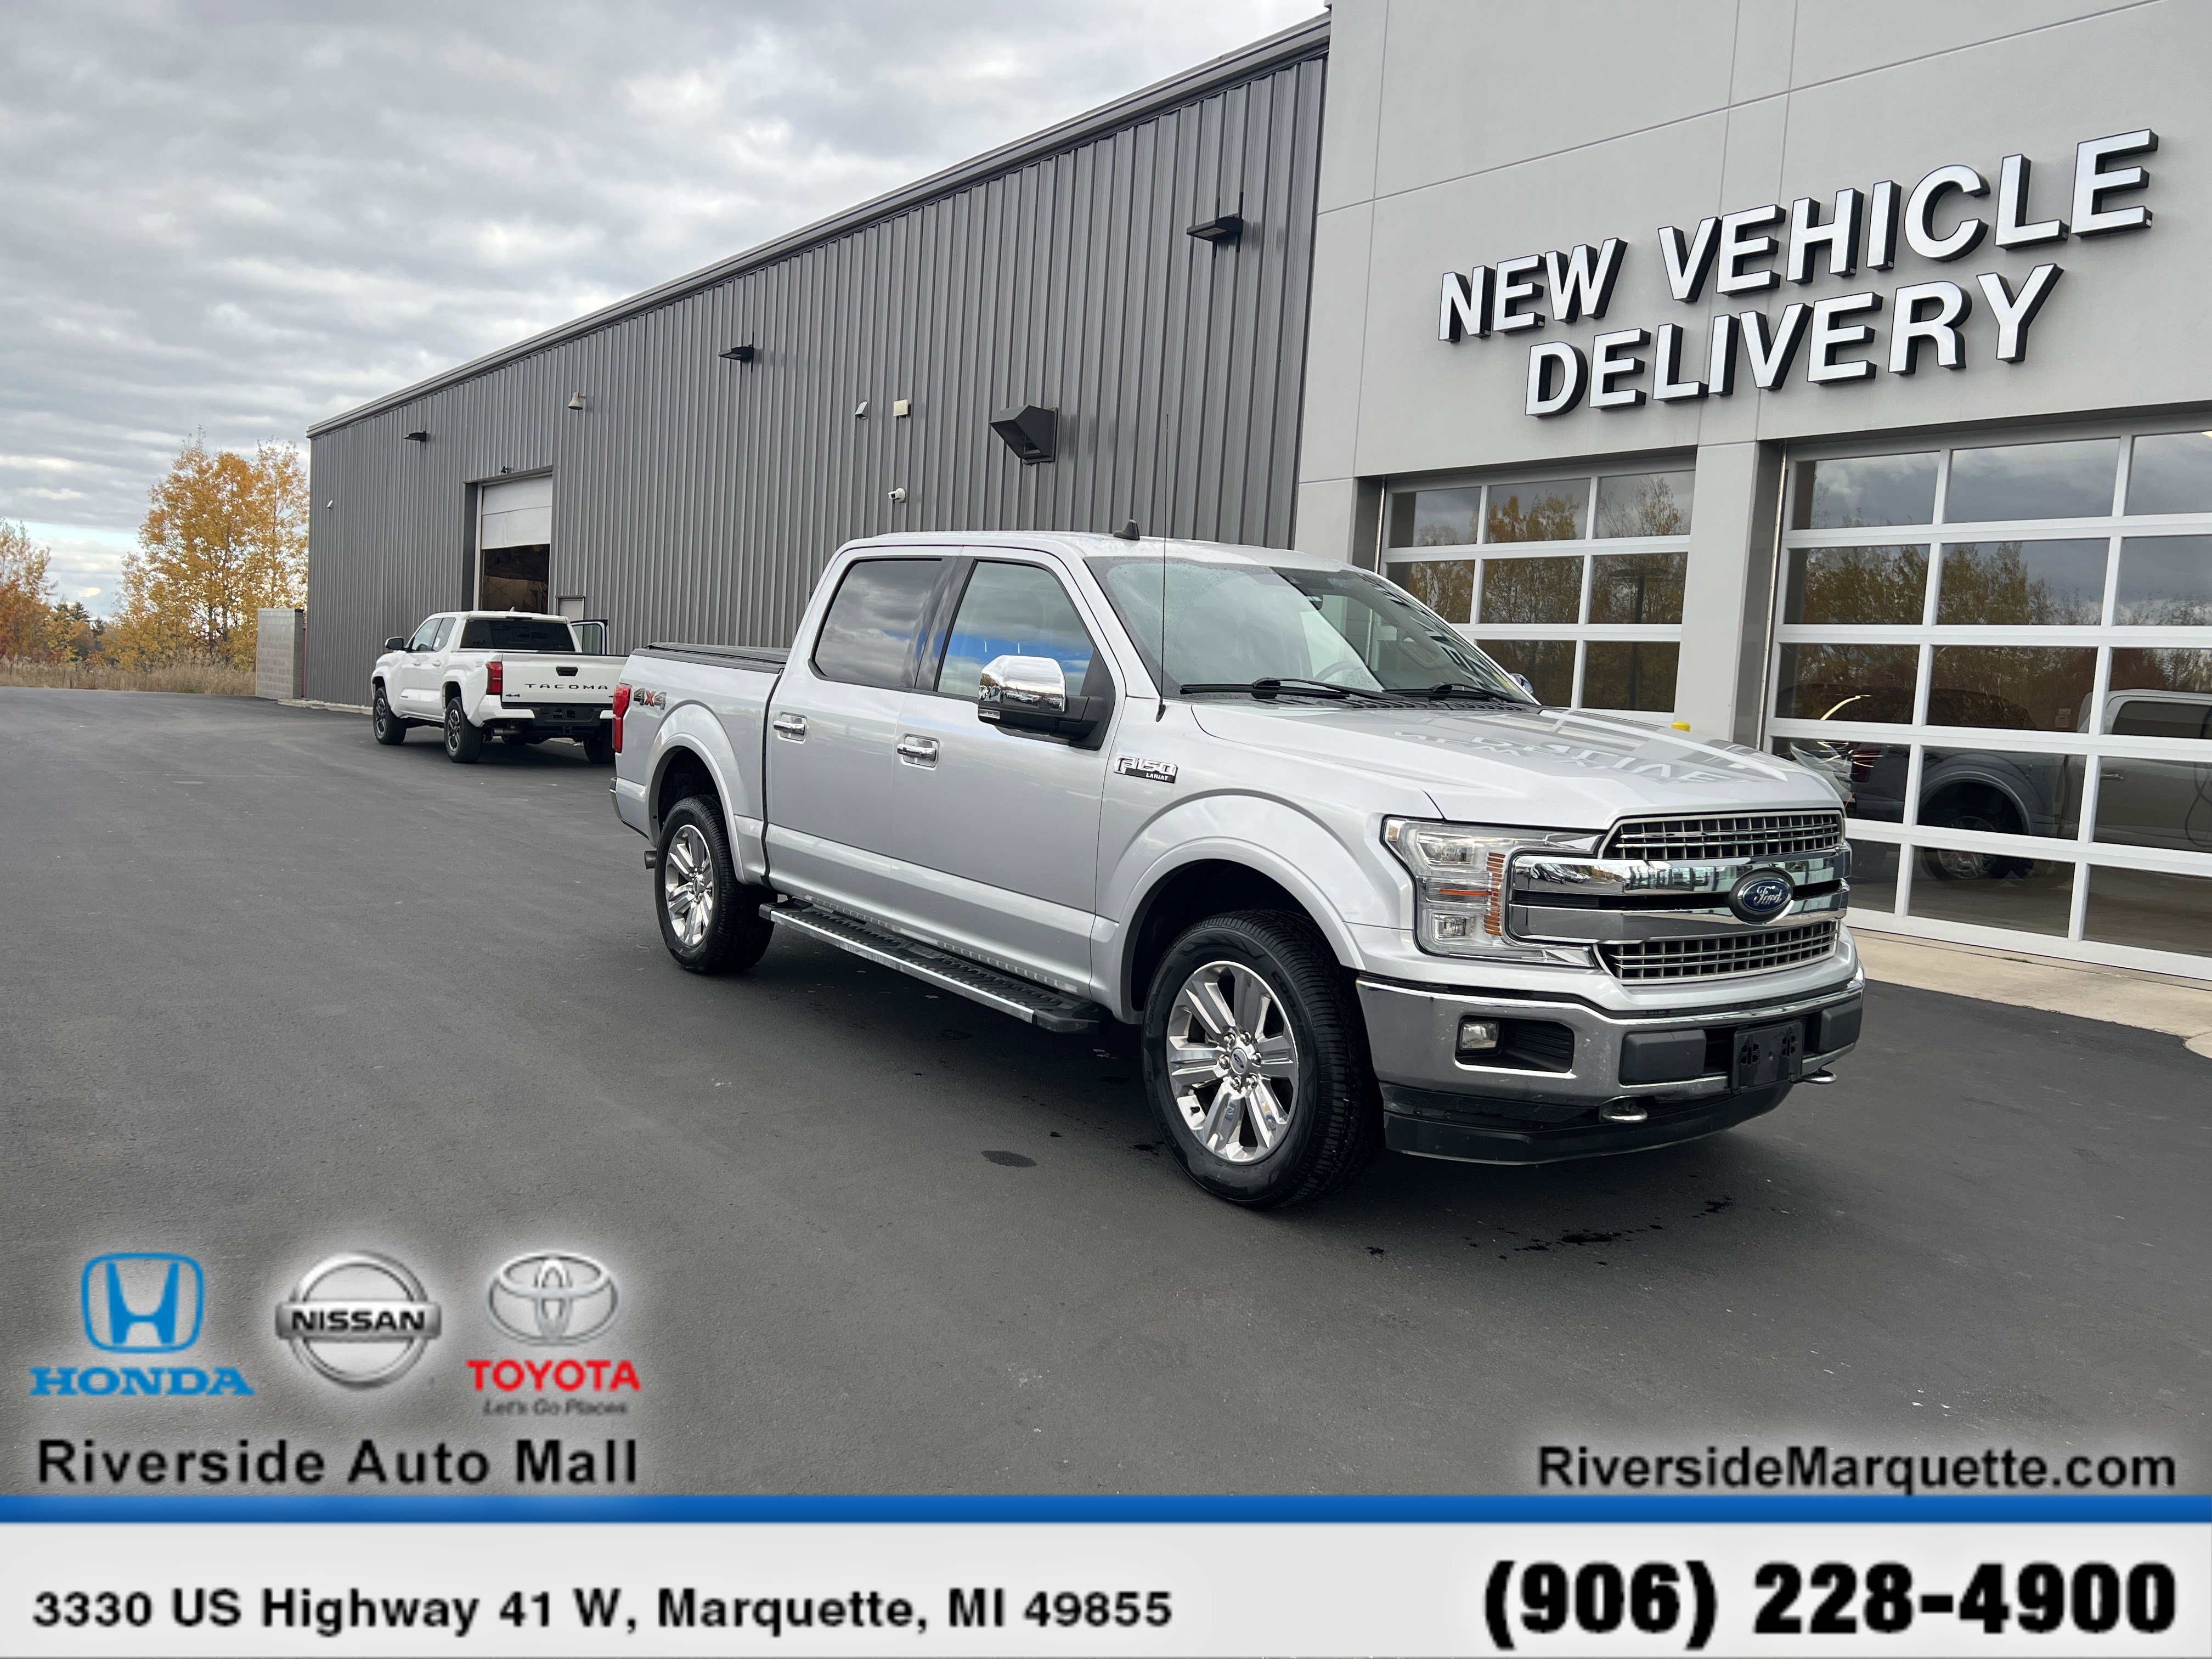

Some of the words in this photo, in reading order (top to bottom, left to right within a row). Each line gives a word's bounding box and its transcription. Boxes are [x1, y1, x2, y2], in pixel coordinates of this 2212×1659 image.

[1438, 238, 1627, 342] NEW
[1657, 128, 2159, 302] VEHICLE
[1525, 263, 2064, 417] DELIVERY
[1146, 772, 1169, 781] LARIAT
[1753, 885, 1782, 905] Ford
